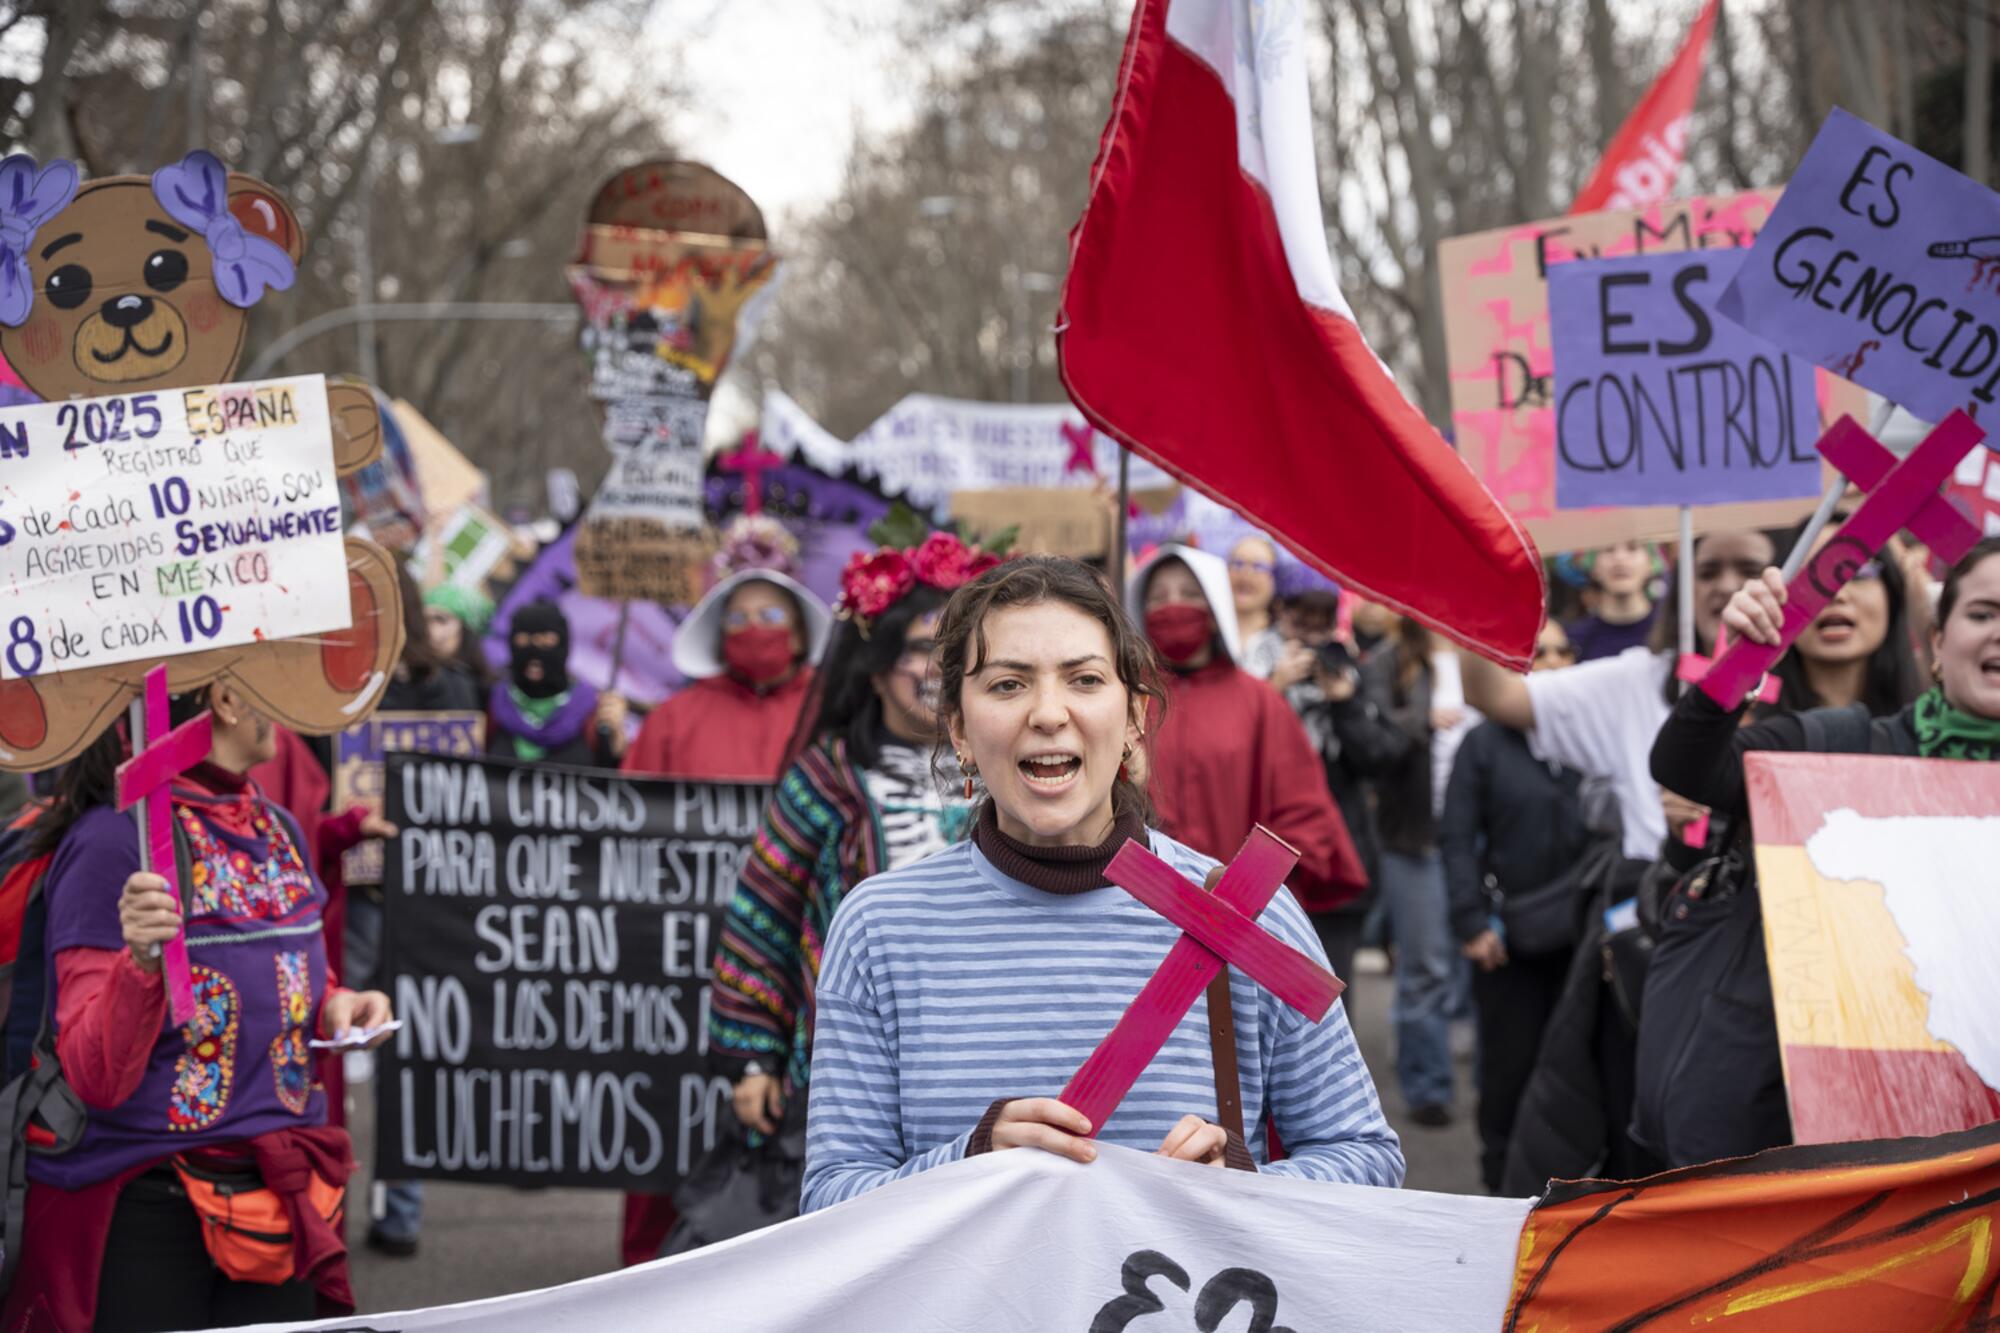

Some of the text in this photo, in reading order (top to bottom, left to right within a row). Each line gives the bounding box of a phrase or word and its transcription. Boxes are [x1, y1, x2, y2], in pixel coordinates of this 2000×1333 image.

[1839, 145, 1914, 229] ES
[1600, 265, 1713, 357] ES
[57, 394, 162, 451] 2025
[183, 388, 297, 435] ESPAÑA
[1557, 352, 1819, 474] CONTROL
[102, 437, 264, 476] REGISTRÓ QUE
[23, 506, 60, 538] de
[149, 476, 191, 519] 10
[26, 505, 341, 579] AGREDIDAS SEXUALMENTE
[92, 552, 269, 600] EN MÉXICO
[6, 594, 223, 677] 8 de CADA 10
[401, 761, 492, 826] UNA
[506, 770, 648, 831] CRISIS
[401, 829, 498, 897] PARA
[506, 834, 582, 901] QUE
[474, 904, 619, 974] SEAN
[395, 974, 472, 1065] NO
[493, 979, 558, 1050] LOS
[565, 980, 689, 1055] DEMOS
[401, 1066, 664, 1176] LUCHEMOS
